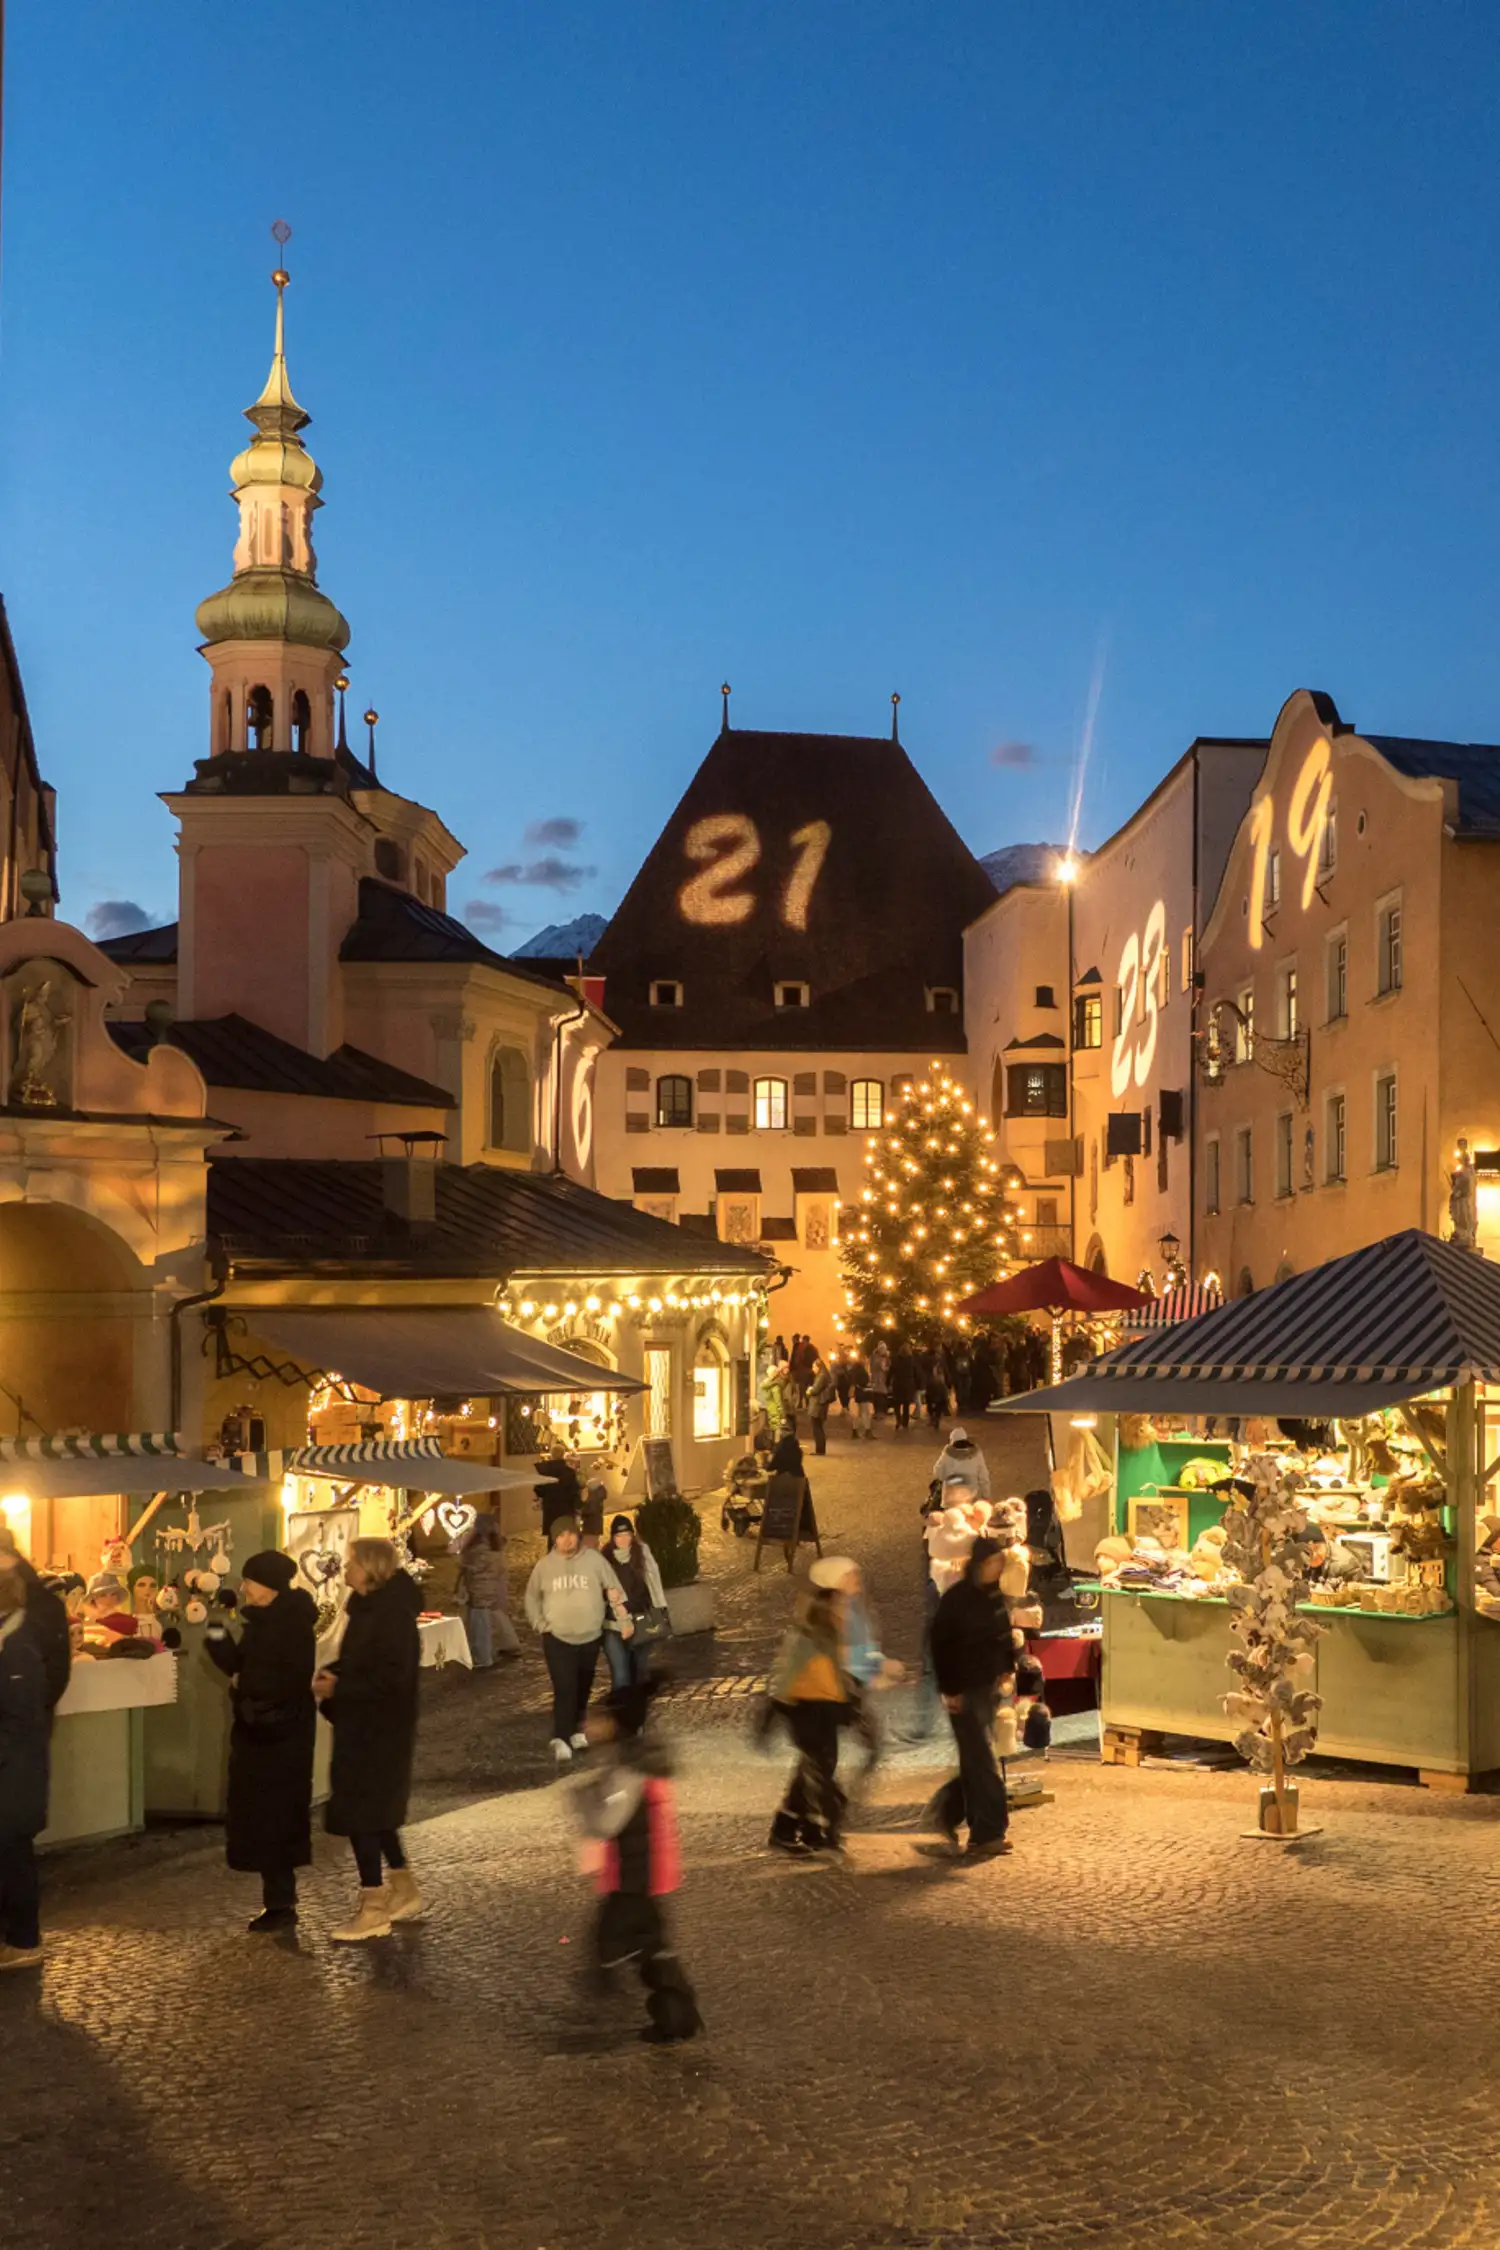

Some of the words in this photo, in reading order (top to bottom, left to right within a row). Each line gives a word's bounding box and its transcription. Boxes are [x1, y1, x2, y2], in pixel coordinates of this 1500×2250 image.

[678, 813, 833, 932] 21
[1247, 735, 1334, 950] 19
[552, 1573, 589, 1592] NIKE
